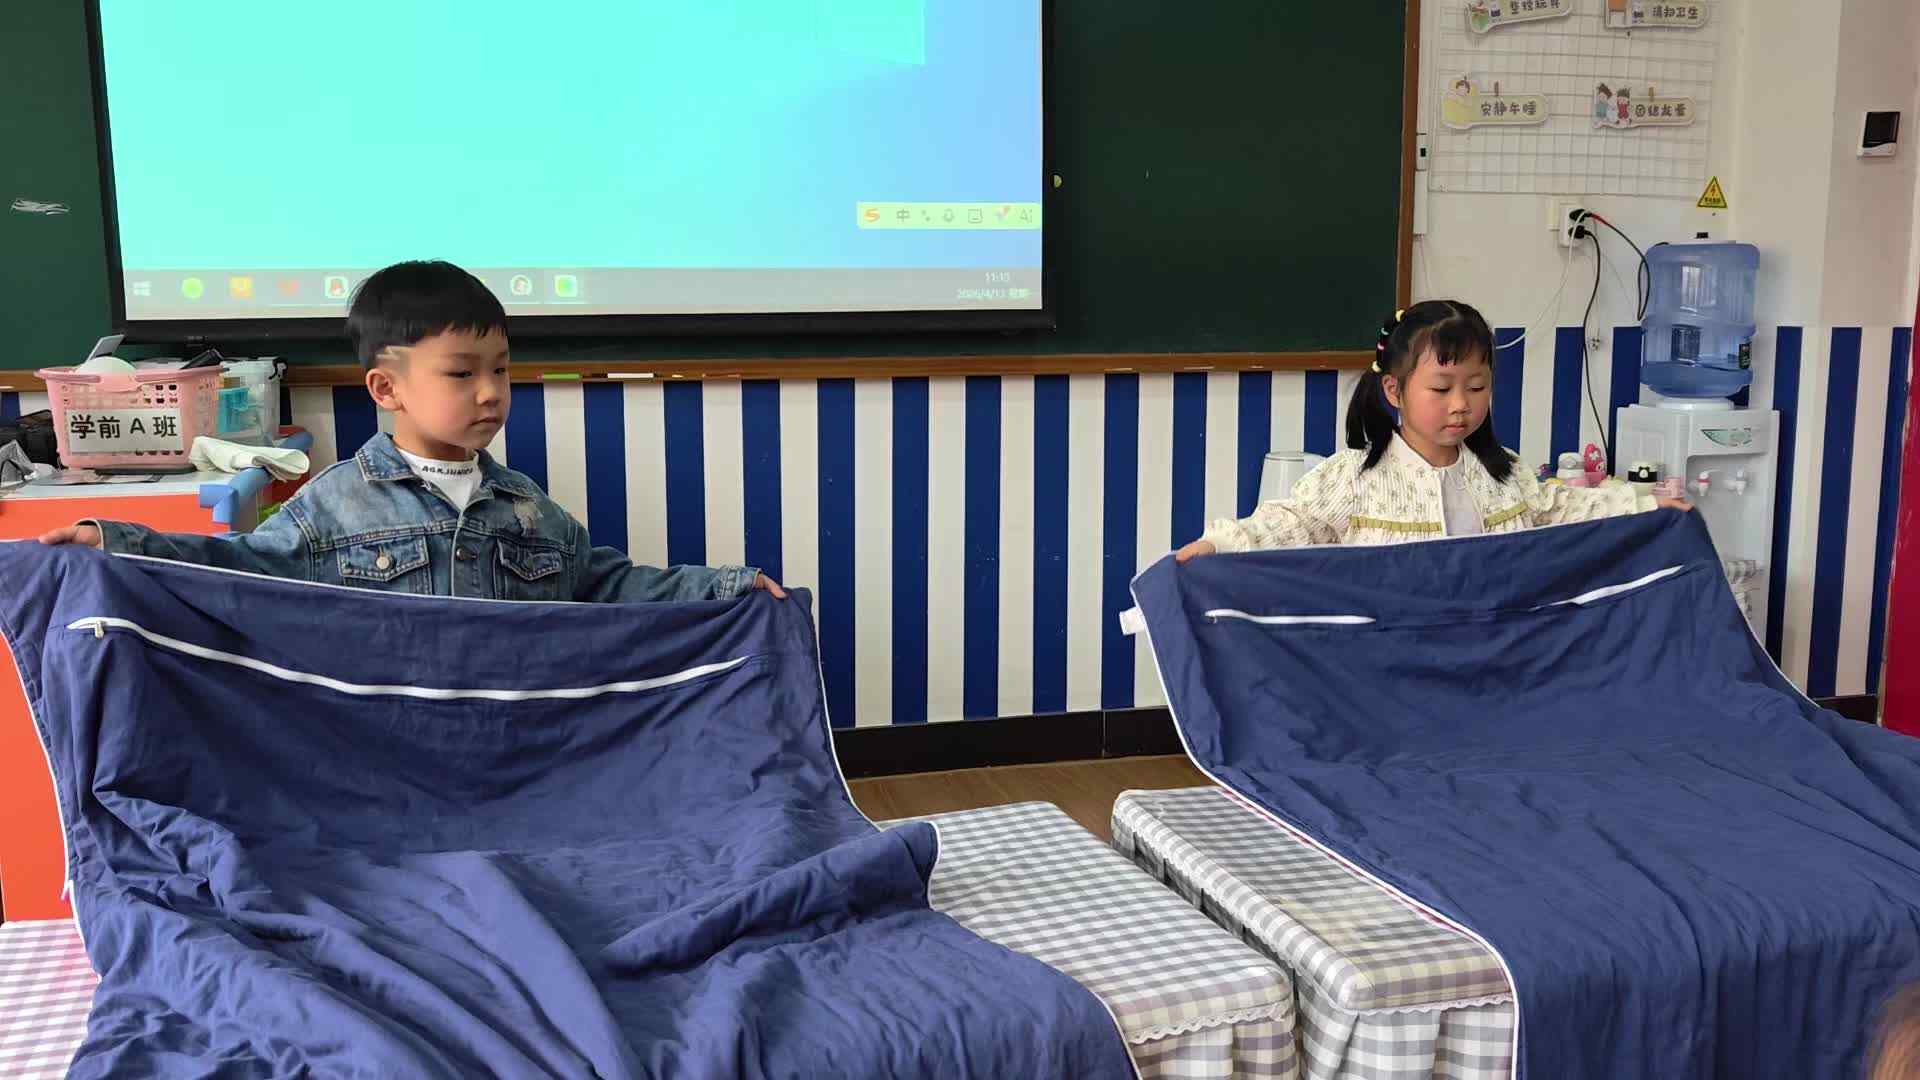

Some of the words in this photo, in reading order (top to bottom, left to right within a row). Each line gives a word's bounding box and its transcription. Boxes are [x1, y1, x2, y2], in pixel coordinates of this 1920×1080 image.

[1481, 100, 1537, 116] 安静午睡
[896, 208, 910, 223] 中
